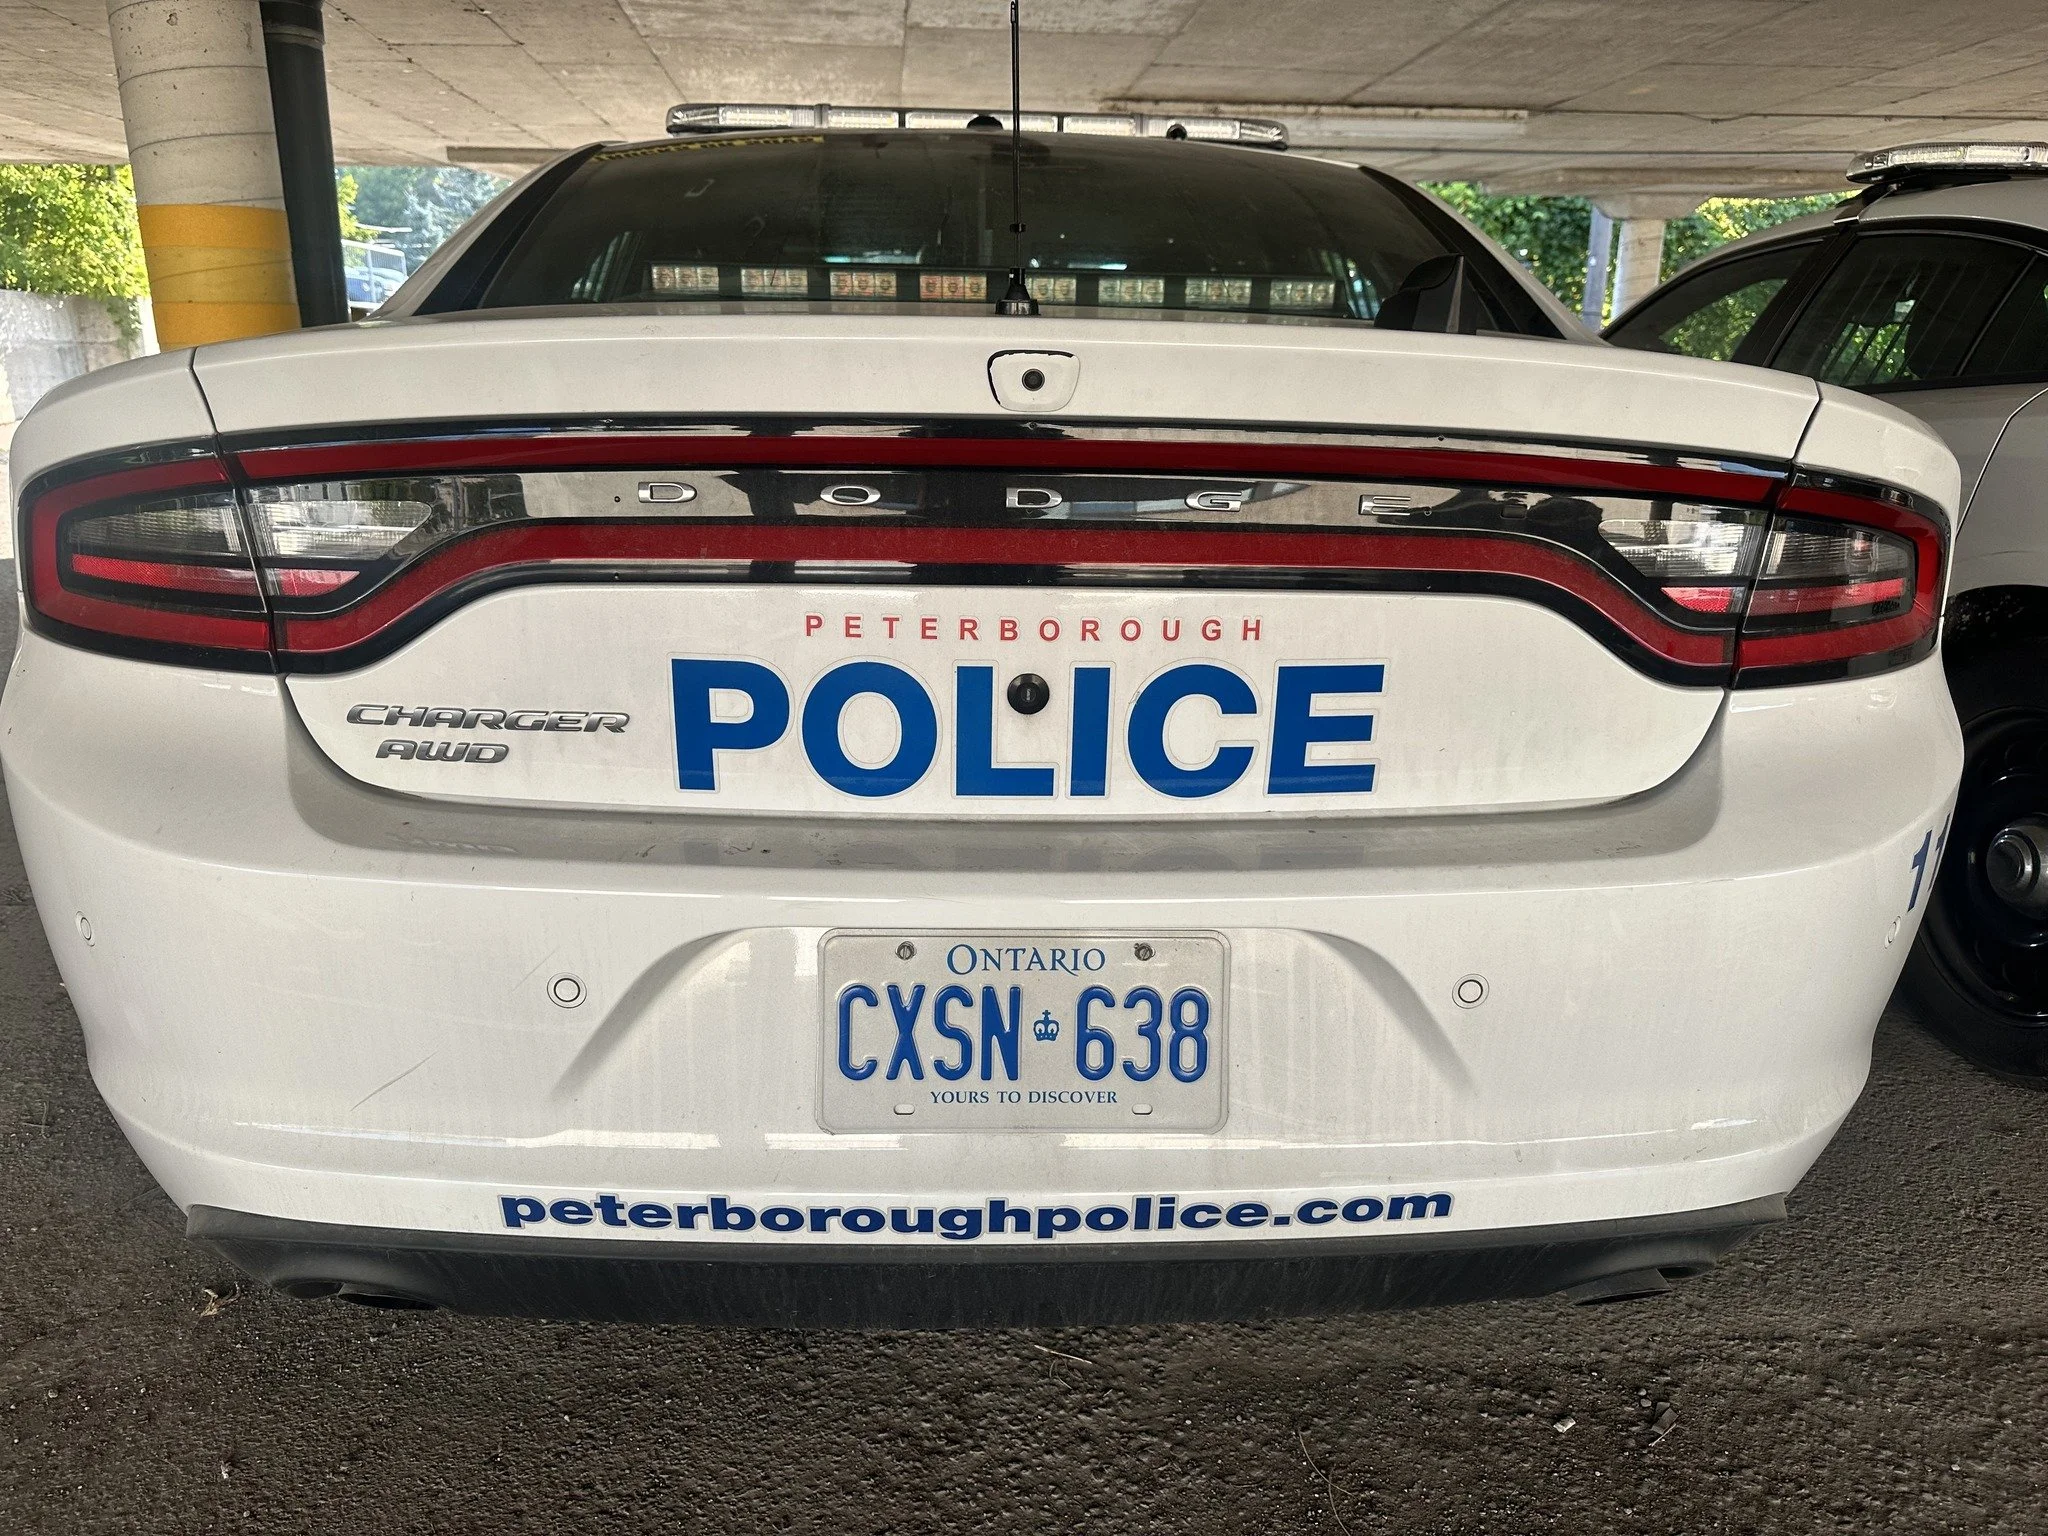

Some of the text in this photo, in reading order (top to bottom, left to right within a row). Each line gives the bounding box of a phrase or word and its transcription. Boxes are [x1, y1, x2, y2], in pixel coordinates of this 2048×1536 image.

[638, 481, 1411, 517] DODGE
[805, 614, 1263, 642] PETERBOROUGH
[346, 703, 630, 733] CHARGER
[671, 658, 1385, 798] POLICE
[375, 739, 510, 763] AWD
[946, 943, 1107, 977] ONTARIO
[837, 984, 1210, 1083] CXSN 638
[930, 1090, 1118, 1104] YOURS TO DISCOVER
[501, 1192, 1453, 1239] peterboroughpolice.com
